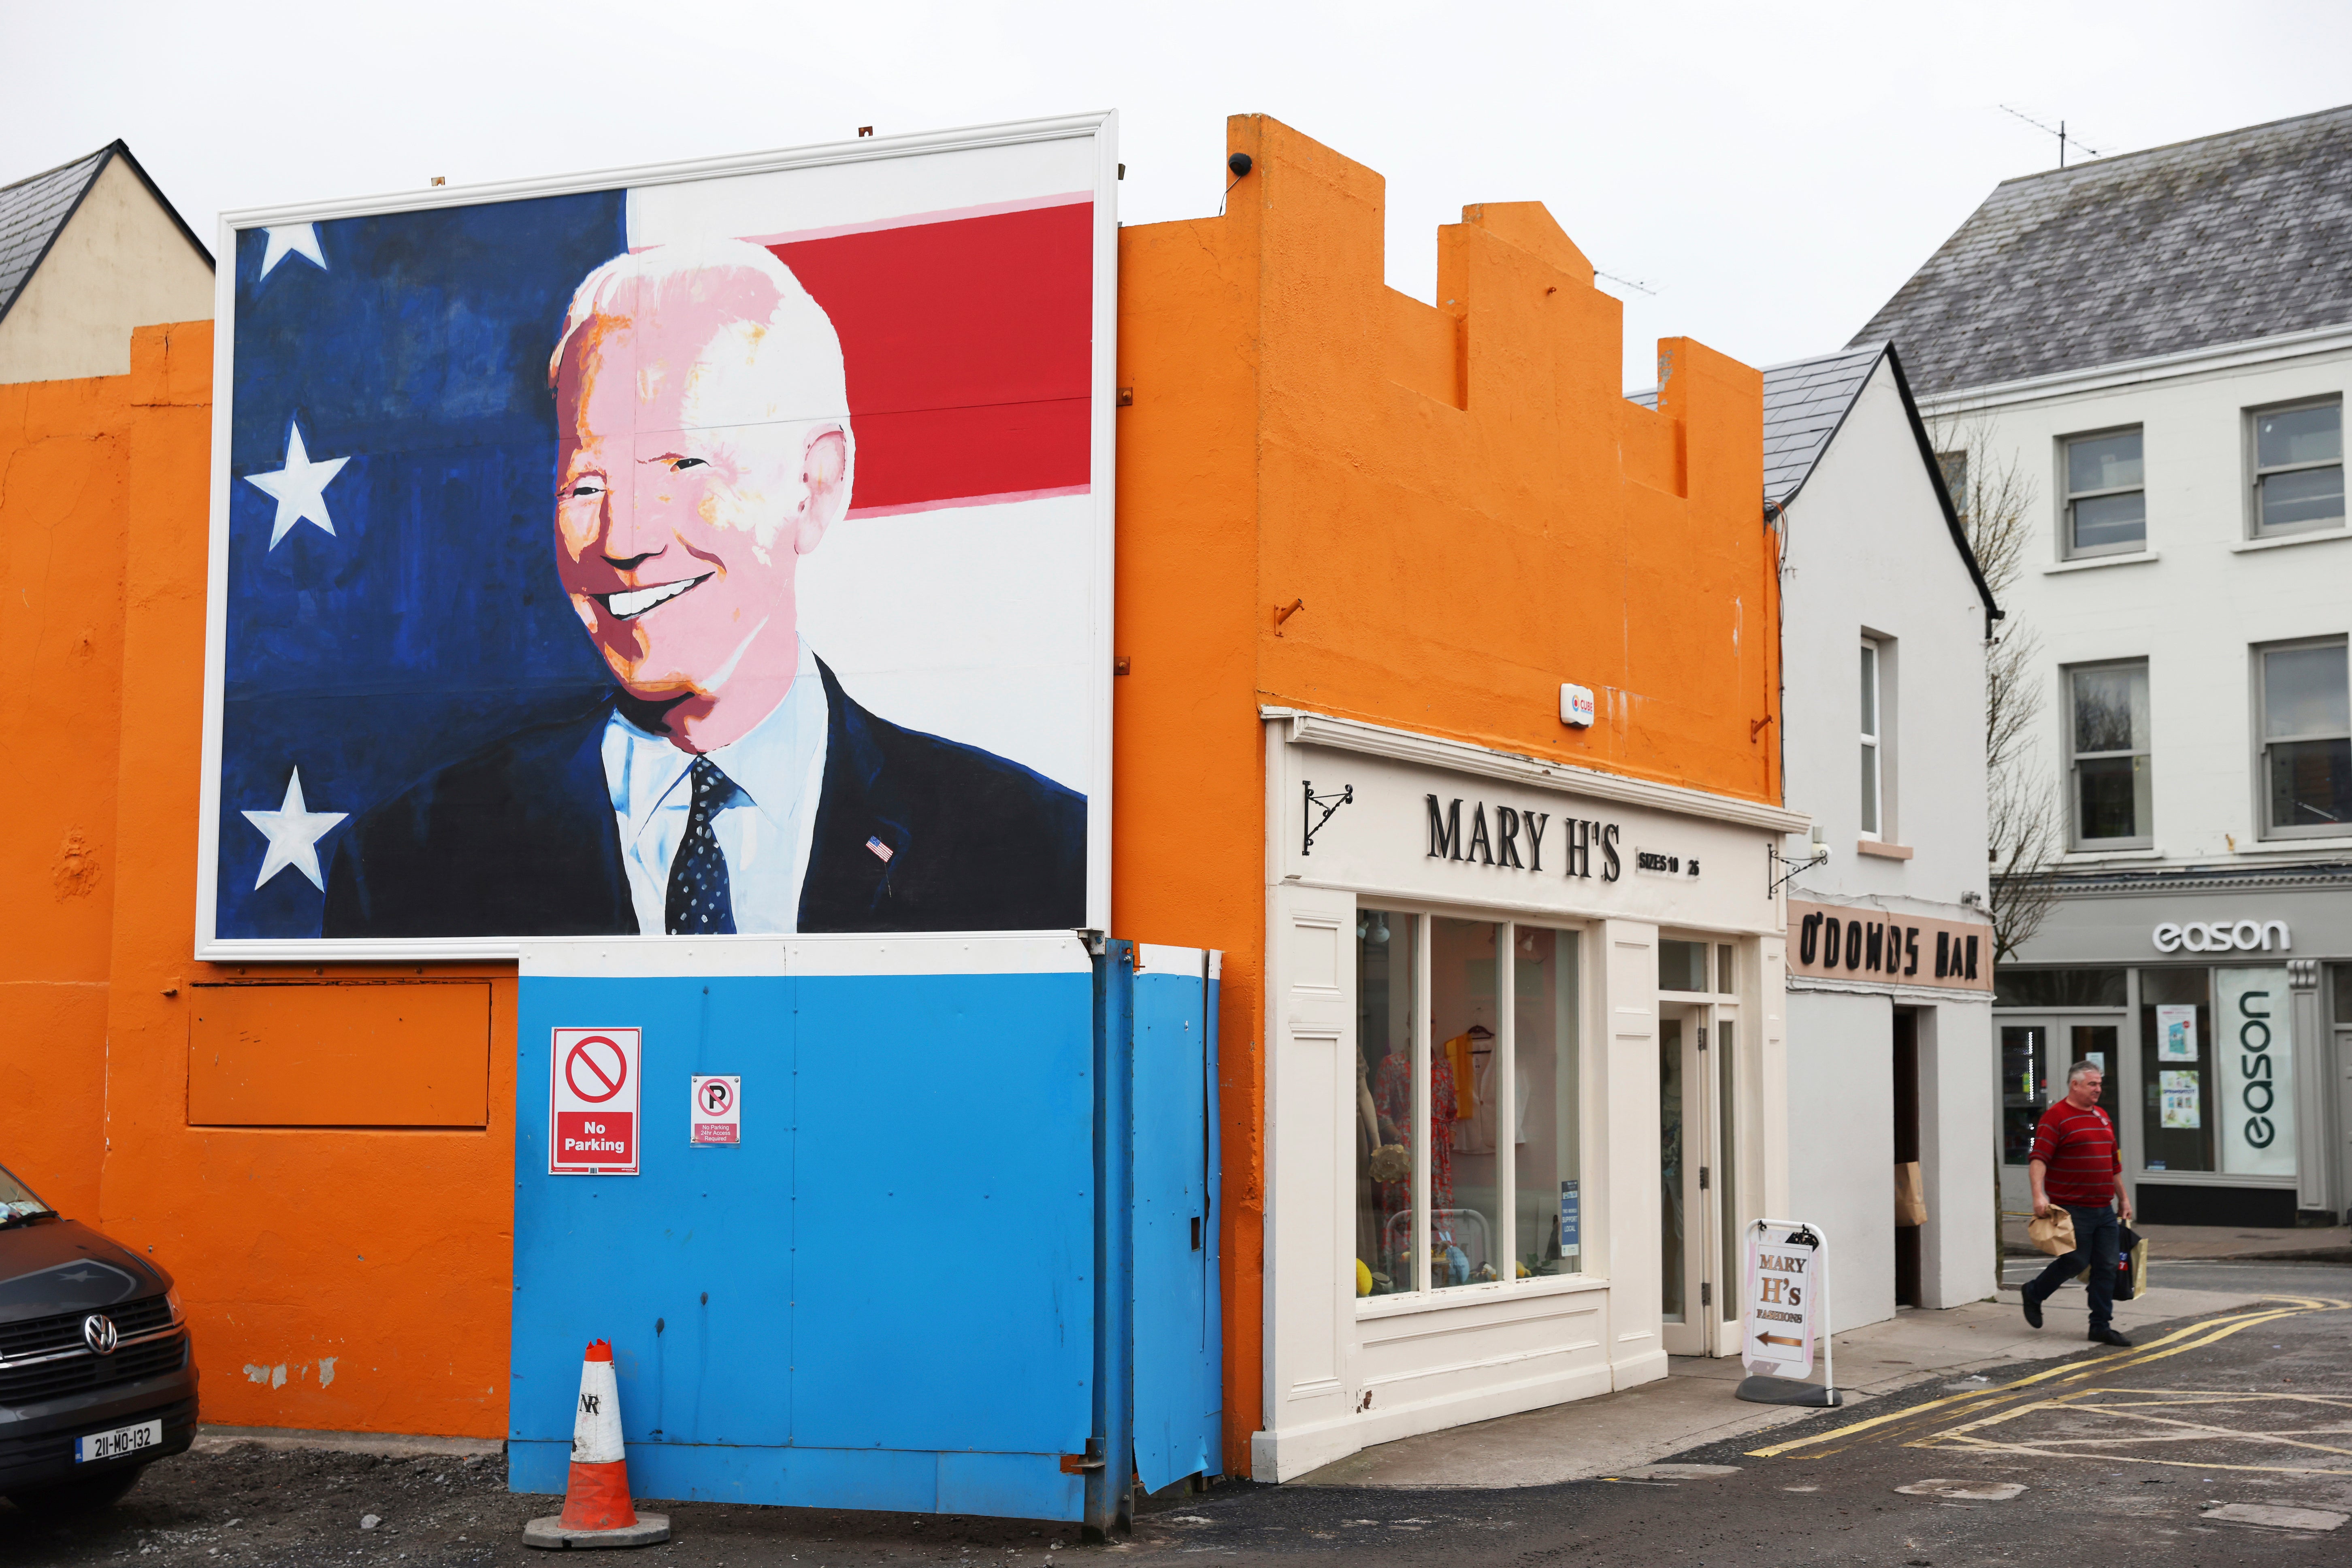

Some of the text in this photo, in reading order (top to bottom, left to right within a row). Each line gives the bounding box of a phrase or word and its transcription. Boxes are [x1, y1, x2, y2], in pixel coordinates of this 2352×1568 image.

[1581, 699, 1593, 712] CUBE
[1427, 794, 1620, 882] MARY H'S
[1639, 852, 1699, 876] SIZES 10 26
[1800, 911, 1978, 980] O'DOWDS BAR
[2152, 919, 2291, 953] eason
[2239, 991, 2275, 1149] eason
[584, 1121, 605, 1134] No
[565, 1138, 624, 1153] Parking
[1759, 1254, 1807, 1273] MARY
[1756, 1309, 1803, 1323] FASHIONS
[95, 1427, 150, 1457] 211-MO-132
